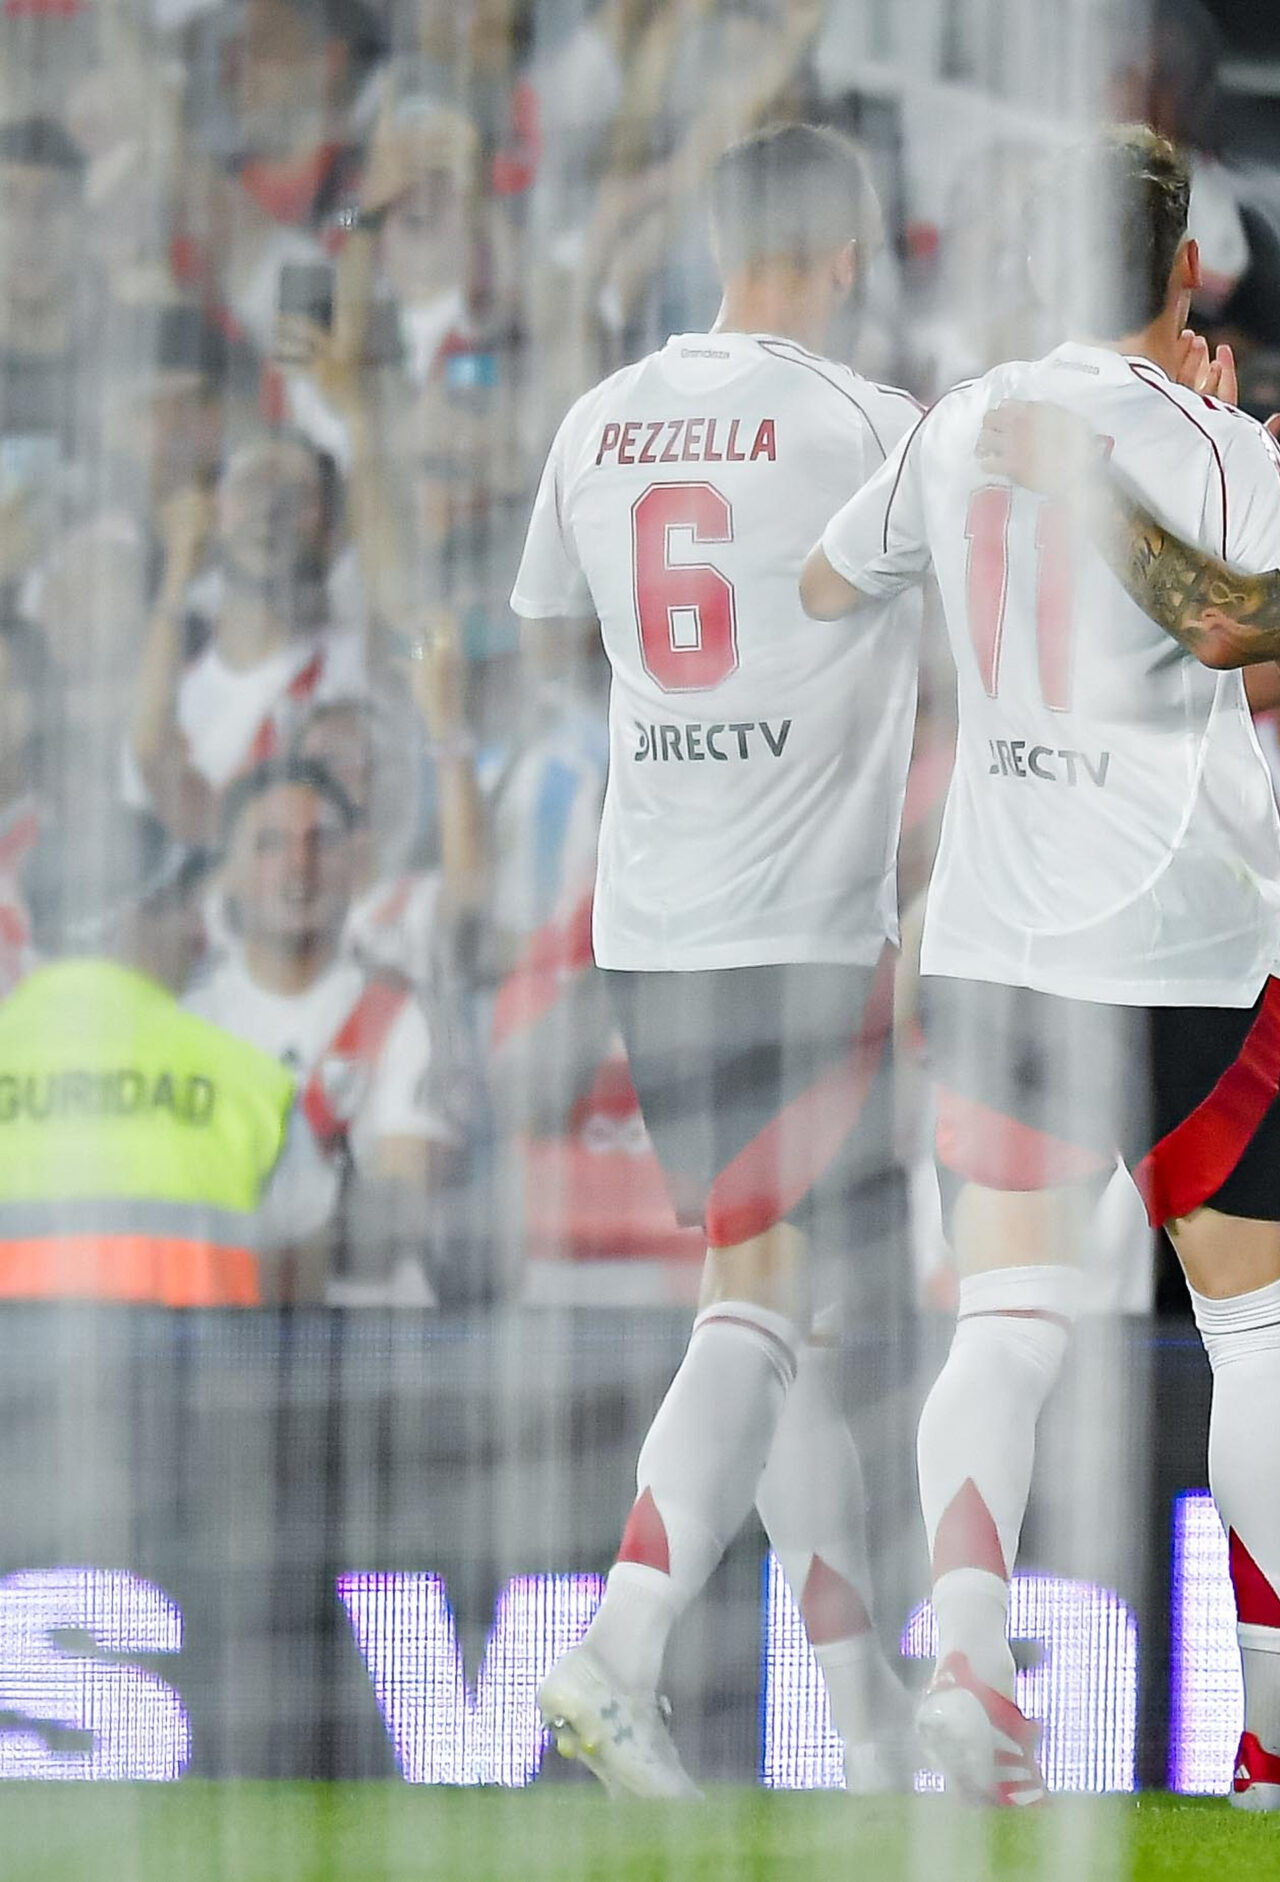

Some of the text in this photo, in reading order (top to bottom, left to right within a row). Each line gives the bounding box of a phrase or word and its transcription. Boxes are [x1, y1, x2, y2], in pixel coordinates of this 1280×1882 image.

[595, 418, 777, 466] PEZZELLA
[630, 481, 740, 694] 6
[965, 484, 1077, 713] 11
[634, 719, 793, 762] DIRECTV
